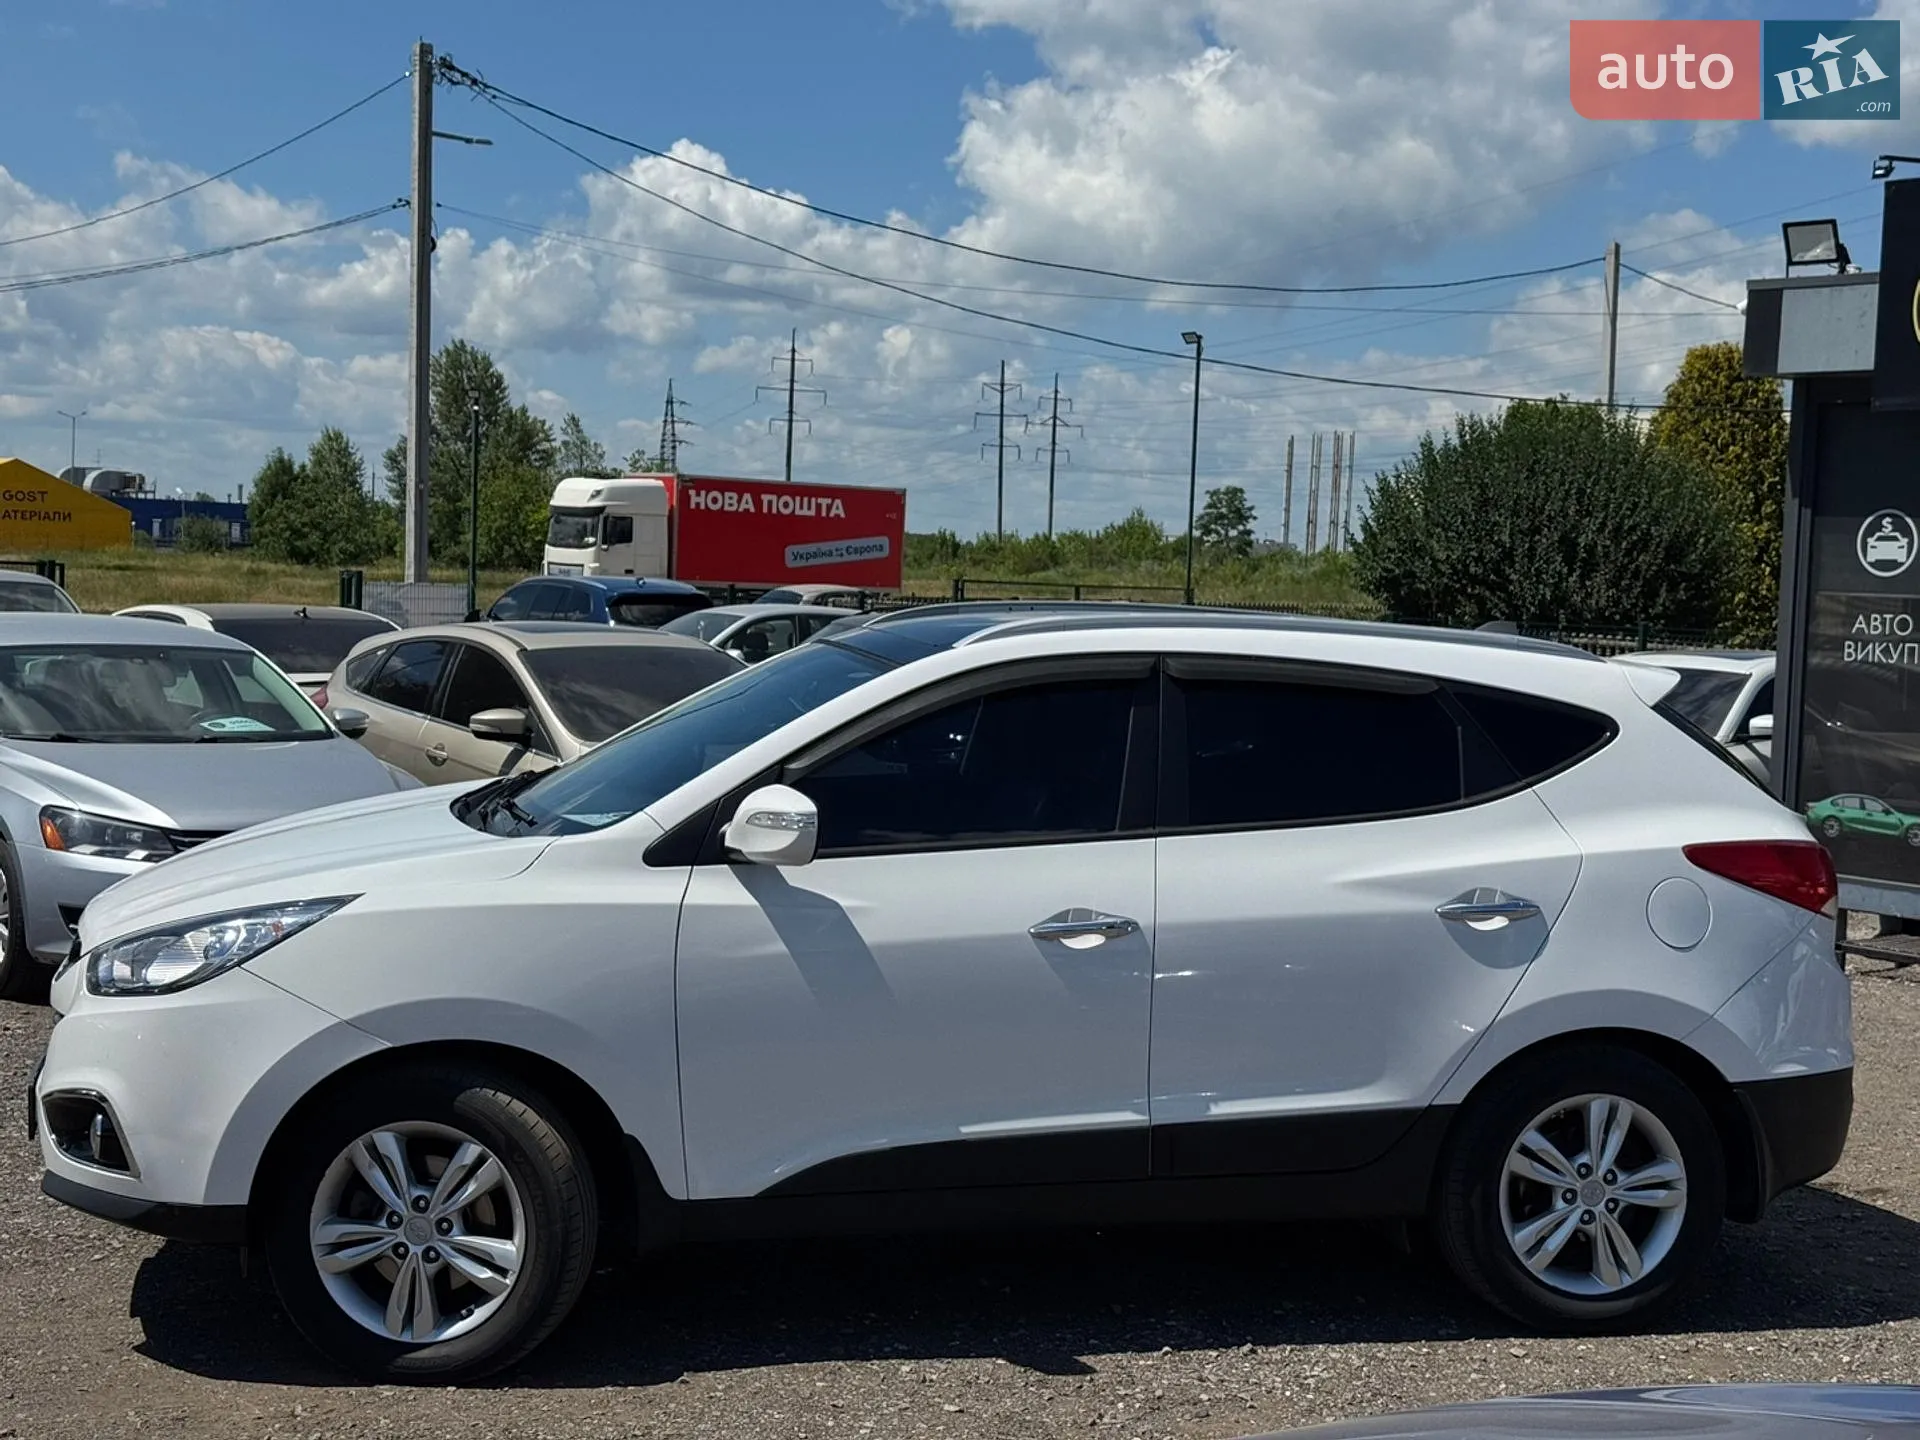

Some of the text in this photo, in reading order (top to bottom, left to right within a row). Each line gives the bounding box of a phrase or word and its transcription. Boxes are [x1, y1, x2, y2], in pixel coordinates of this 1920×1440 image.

[2, 490, 49, 503] GOST
[688, 489, 846, 518] НОВА ПОШТА
[791, 542, 885, 562] Україна Європа
[1851, 614, 1914, 636] АВТО
[1843, 640, 1920, 665] ВИКУП
